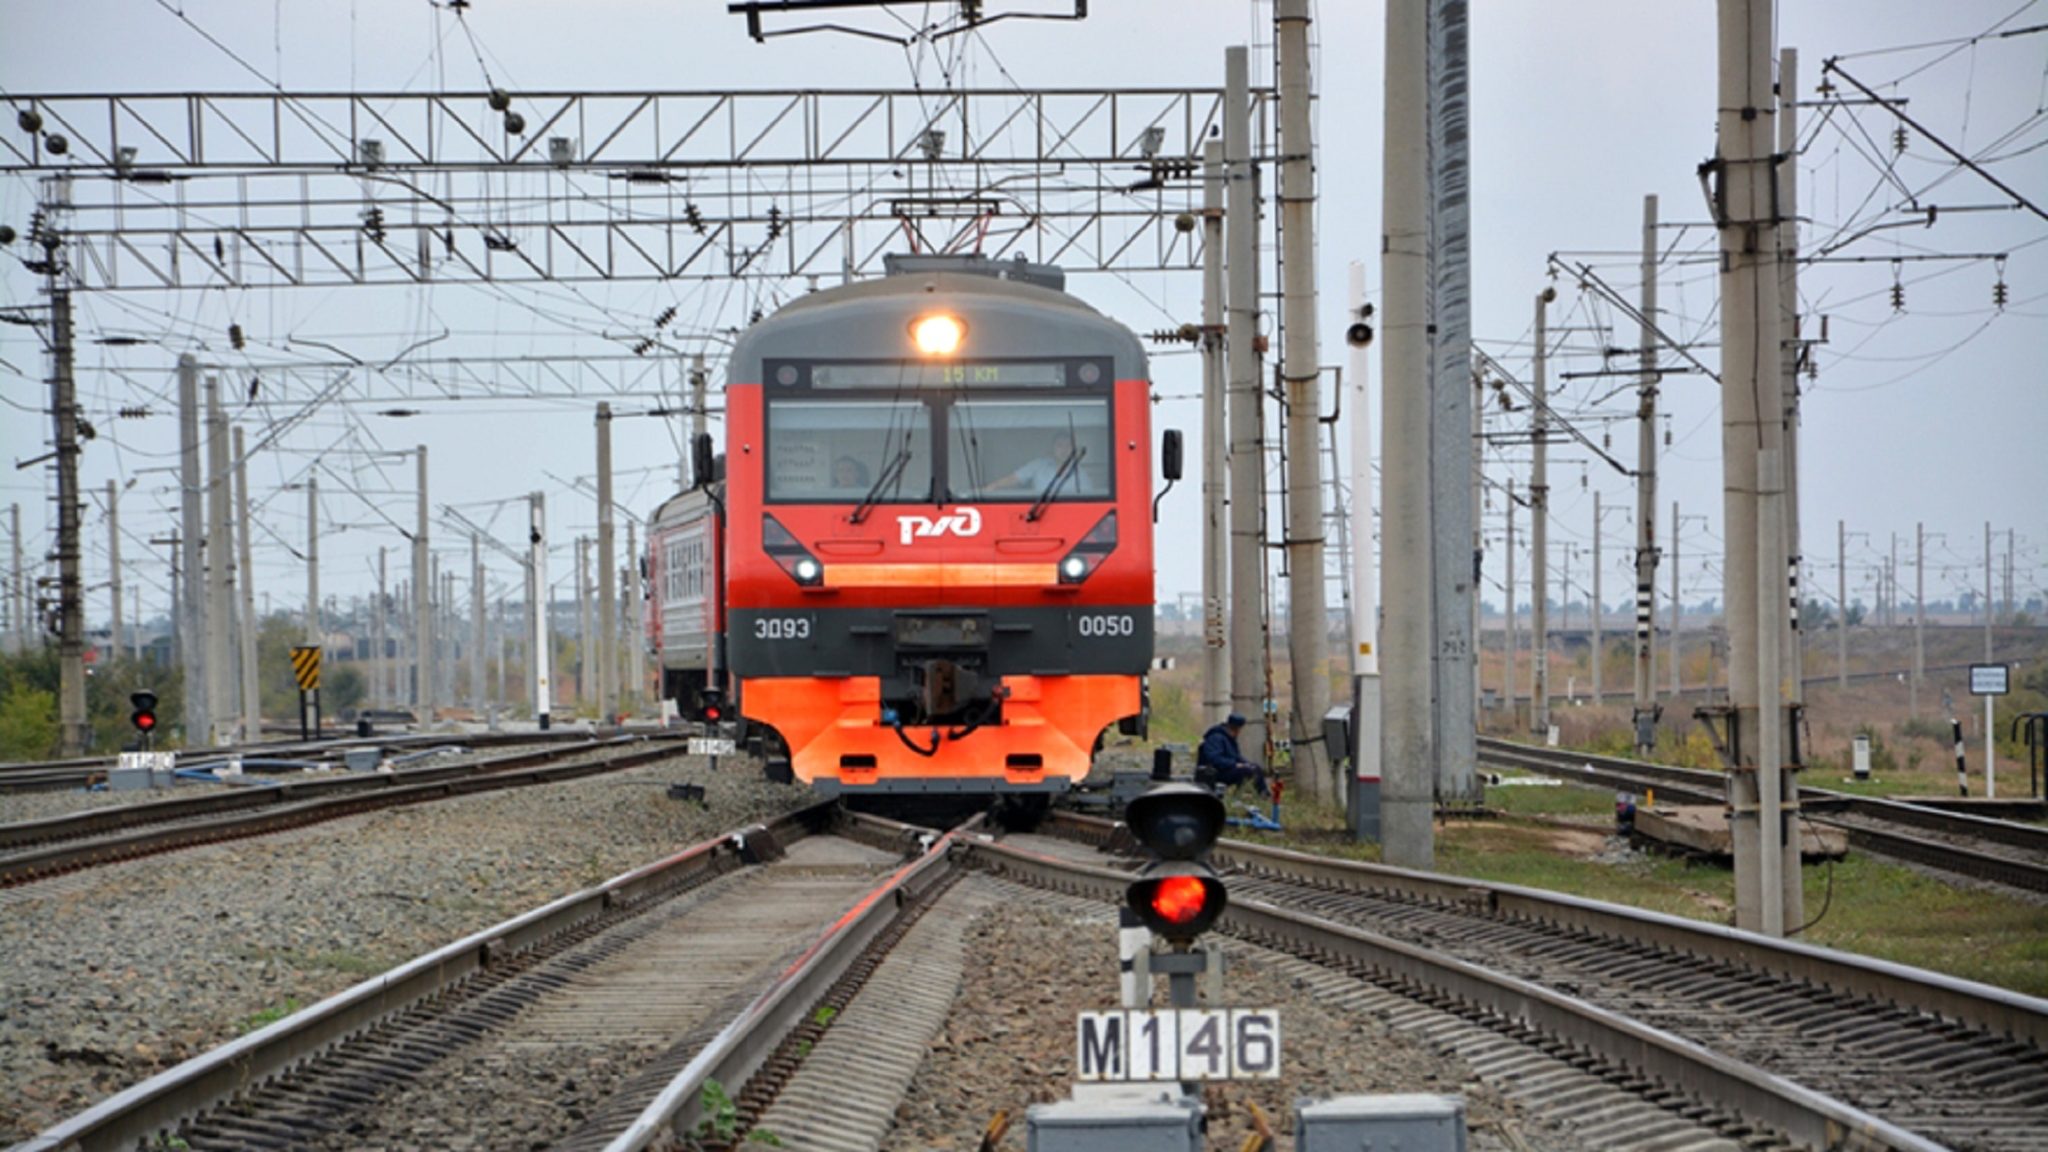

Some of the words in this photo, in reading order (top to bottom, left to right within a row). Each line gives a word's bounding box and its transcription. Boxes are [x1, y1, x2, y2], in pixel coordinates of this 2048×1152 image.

[897, 506, 982, 545] РЖД
[1079, 615, 1134, 637] 0050
[1081, 1015, 1275, 1075] М146
